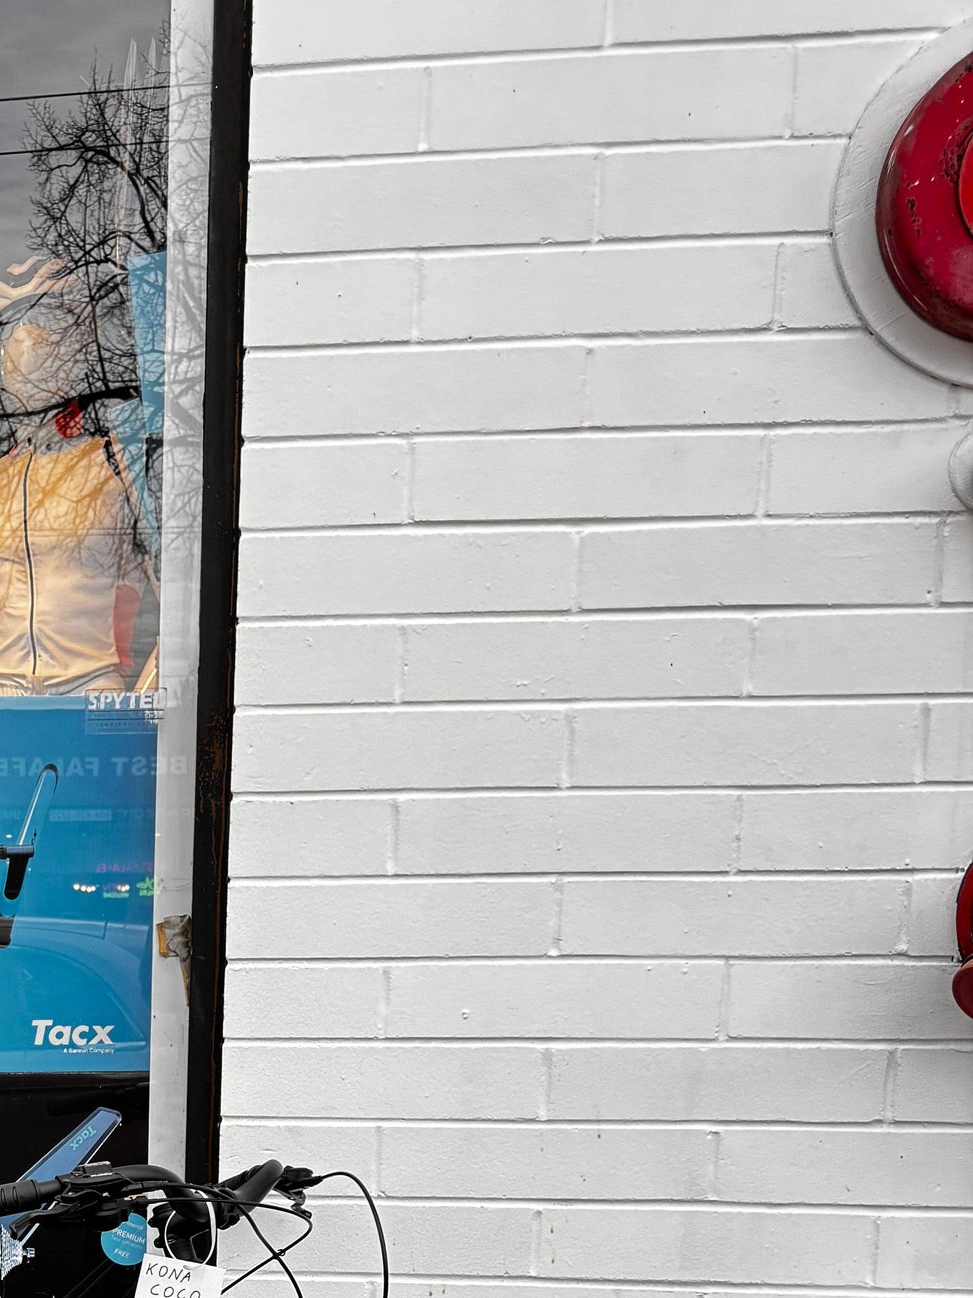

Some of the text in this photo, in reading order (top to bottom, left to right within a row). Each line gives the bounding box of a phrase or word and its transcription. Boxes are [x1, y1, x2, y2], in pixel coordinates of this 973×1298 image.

[31, 1019, 115, 1046] Tacx
[69, 1126, 97, 1151] Tacx
[112, 1229, 146, 1245] PREMIUM
[114, 1248, 131, 1259] FREE
[145, 1262, 191, 1283] KONA
